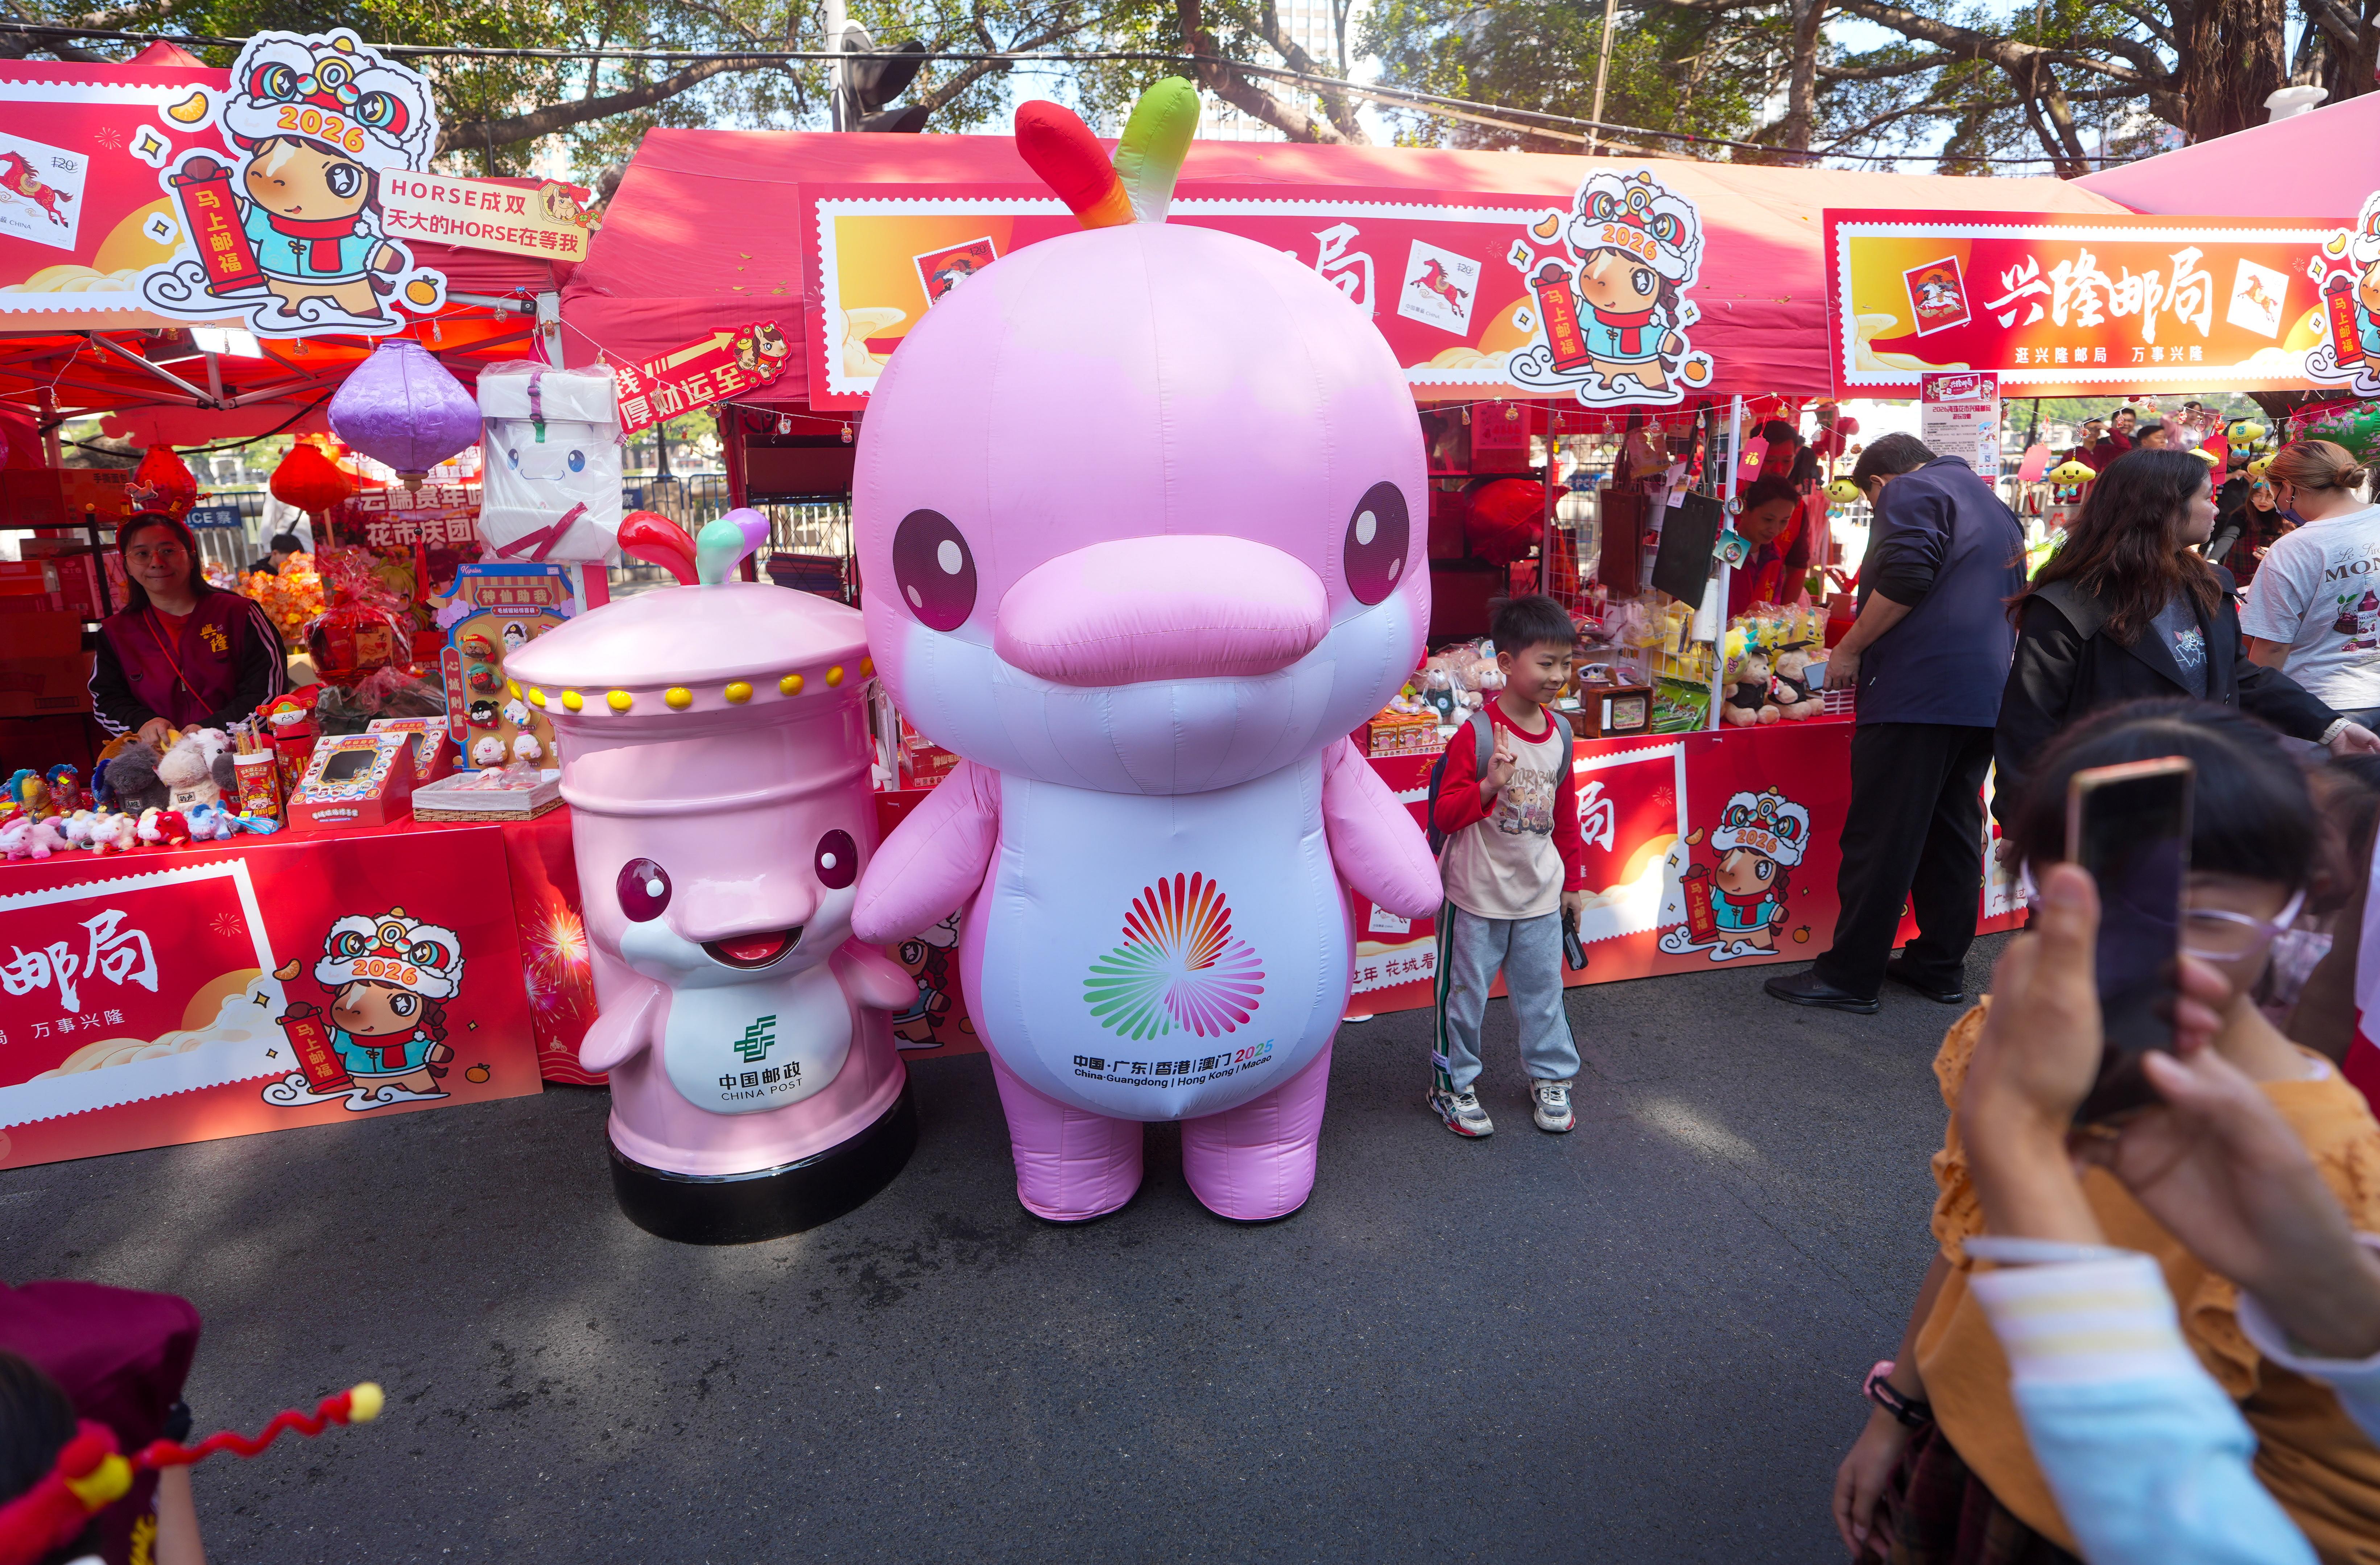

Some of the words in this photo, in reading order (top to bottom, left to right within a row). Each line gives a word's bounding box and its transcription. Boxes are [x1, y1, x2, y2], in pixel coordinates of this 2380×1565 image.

[277, 105, 365, 153] 2026
[391, 179, 526, 215] HORSE成双
[9, 220, 31, 230] CHINA
[197, 190, 242, 273] 马上邮福
[388, 208, 579, 253] 天大的HORSE在等我
[1602, 224, 1657, 260] 2026
[1311, 222, 1375, 320] 局
[1983, 247, 2212, 344] 兴隆邮局
[1425, 311, 1440, 320] CHINA
[1548, 290, 1577, 355] 马上邮福
[2335, 297, 2354, 353] 马上邮福
[2015, 347, 2107, 363] 逛兴隆邮局
[2132, 346, 2203, 362] 万事兴隆
[619, 361, 745, 429] 厚财运至
[1744, 451, 1760, 466] 福
[2334, 548, 2355, 564] Le
[482, 589, 548, 604] 神仙助我
[1575, 780, 1615, 852] 局
[1735, 829, 1777, 853] 2026
[1691, 883, 1708, 931] 马上邮福
[0, 908, 159, 1013] 邮局
[351, 959, 418, 986] 2026
[1385, 952, 1436, 977] 花城看
[31, 1008, 125, 1039] 万事兴隆
[295, 1023, 334, 1079] 马上邮福
[1234, 1039, 1274, 1064] 2025
[719, 1061, 801, 1090] 中国邮政
[1177, 1076, 1206, 1088] Hong
[1208, 1067, 1234, 1081] Kong
[1242, 1053, 1272, 1070] Macao
[721, 1089, 765, 1101] CHINA
[770, 1077, 802, 1094] POST
